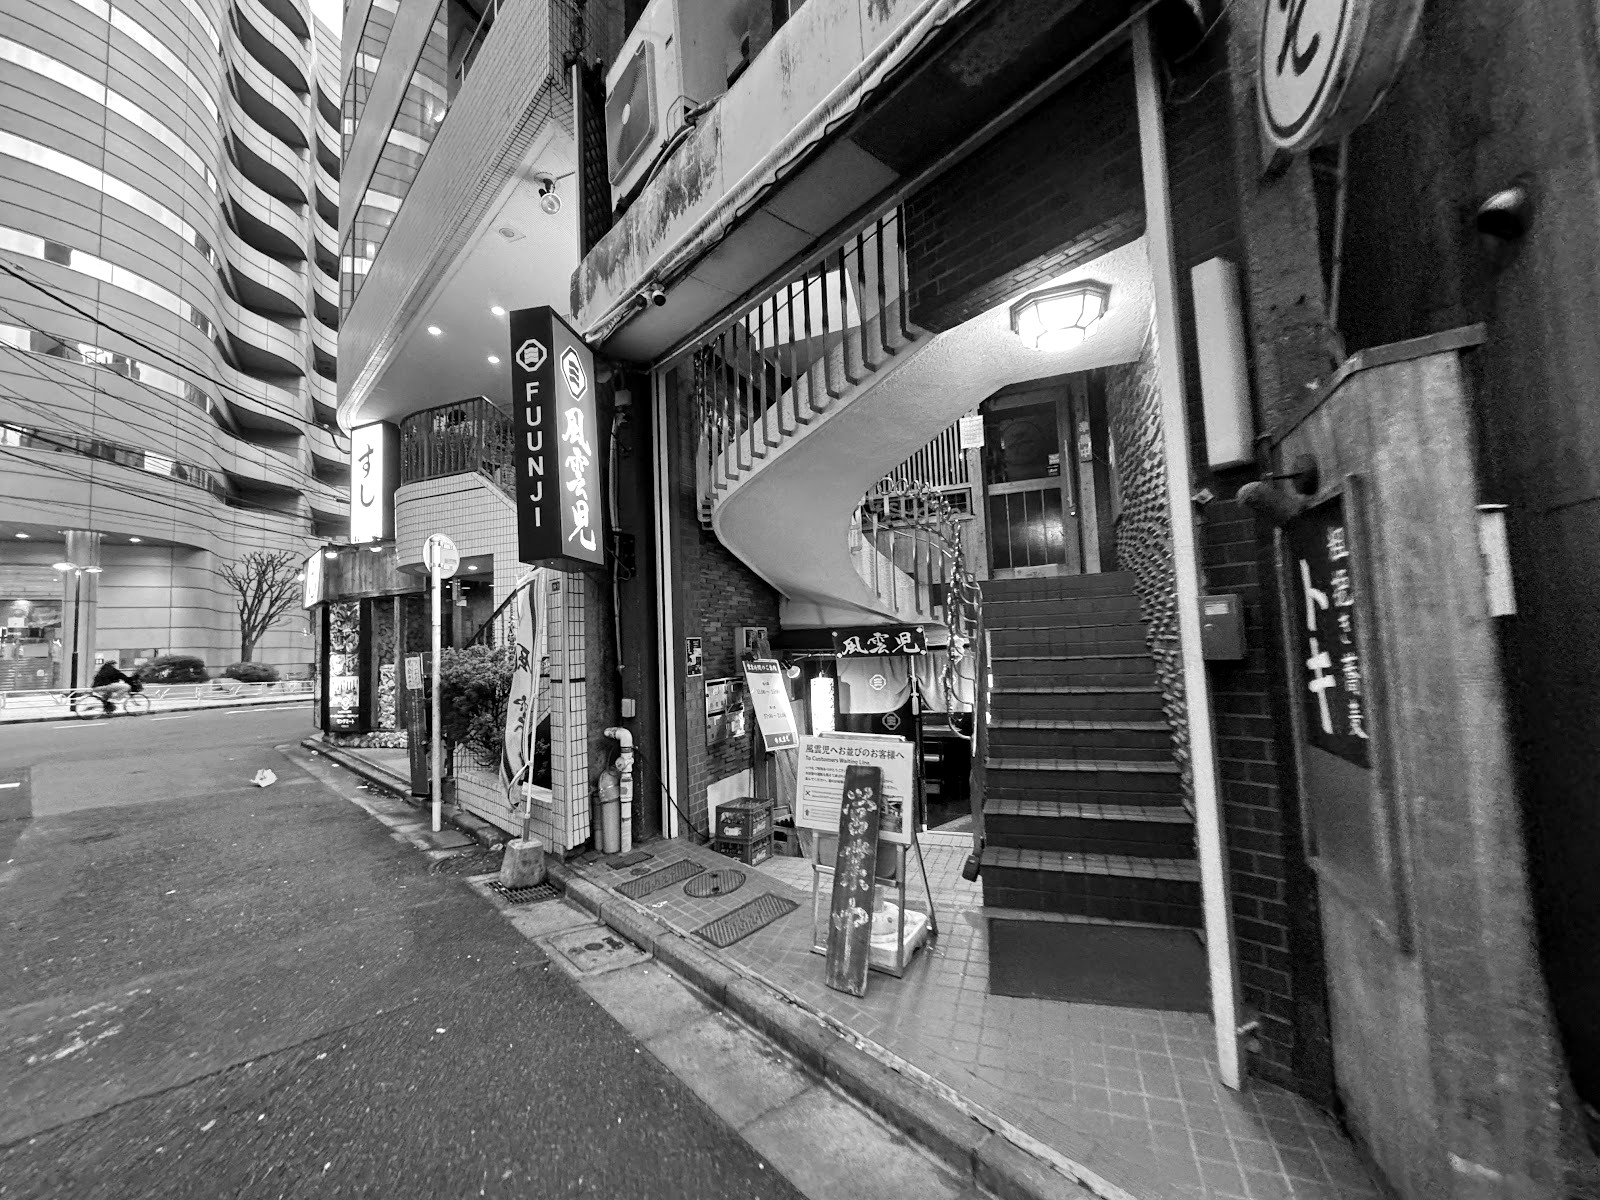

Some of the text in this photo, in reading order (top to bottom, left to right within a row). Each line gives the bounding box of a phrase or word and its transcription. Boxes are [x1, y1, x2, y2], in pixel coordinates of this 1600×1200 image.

[357, 443, 375, 508] すし
[525, 381, 544, 527] FUUNJI
[841, 631, 921, 656] 風雲児
[1299, 558, 1336, 735] トキ
